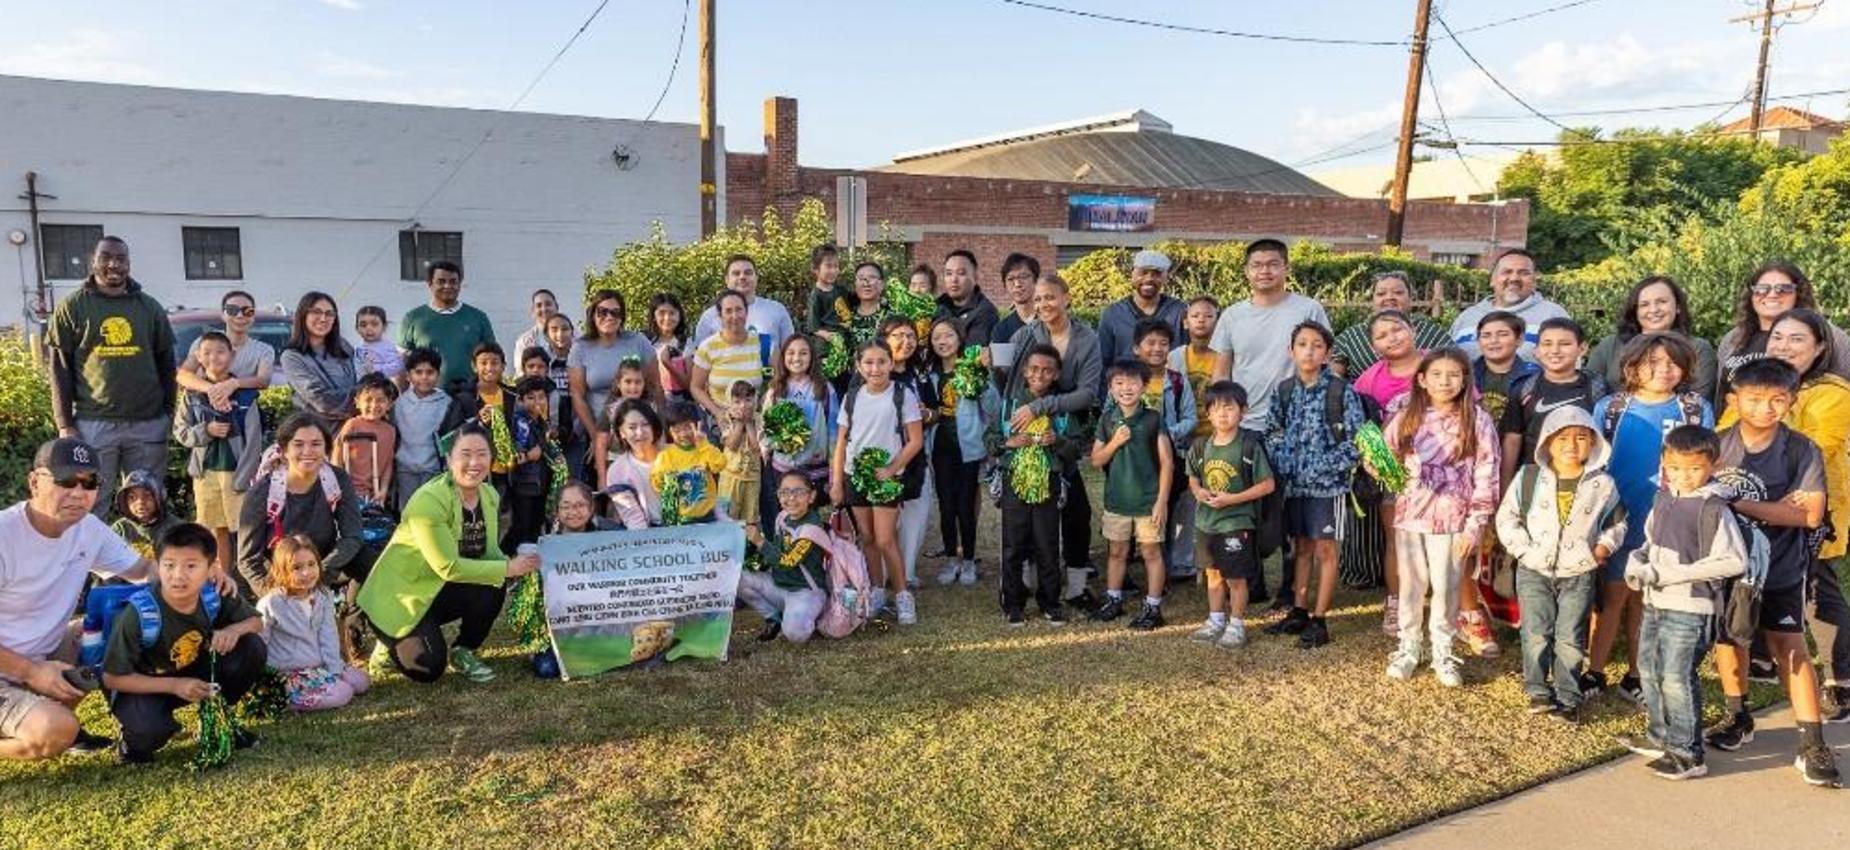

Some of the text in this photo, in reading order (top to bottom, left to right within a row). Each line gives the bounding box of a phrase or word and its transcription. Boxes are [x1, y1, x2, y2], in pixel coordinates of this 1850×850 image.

[555, 551, 730, 576] WALKING SCHOOL BUS
